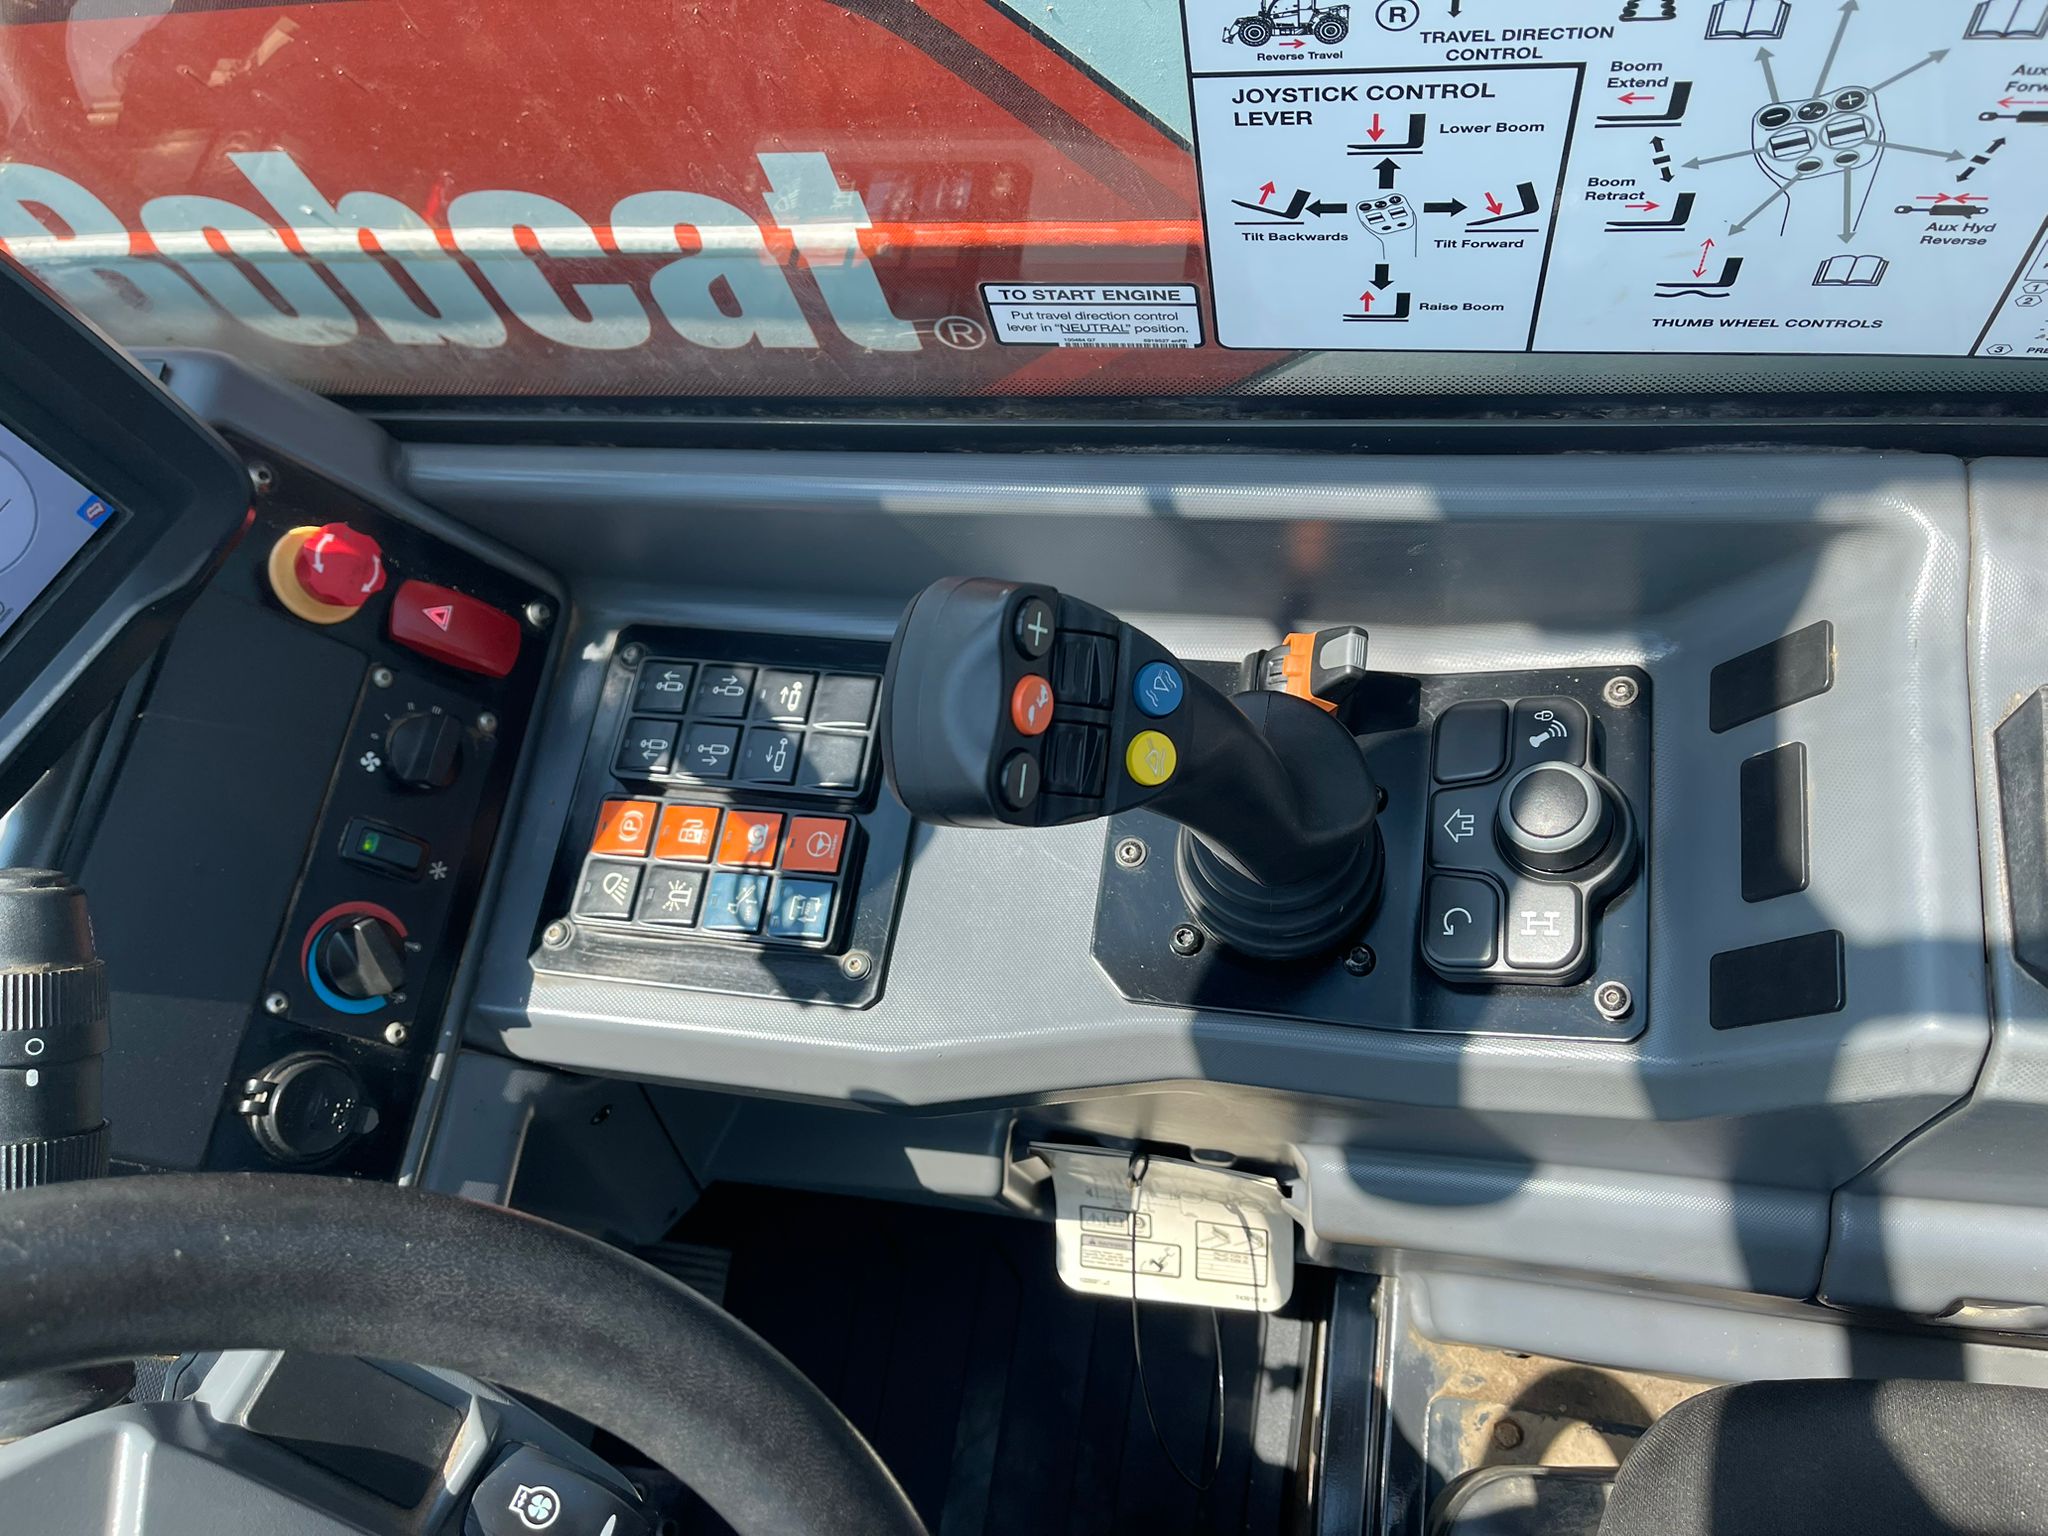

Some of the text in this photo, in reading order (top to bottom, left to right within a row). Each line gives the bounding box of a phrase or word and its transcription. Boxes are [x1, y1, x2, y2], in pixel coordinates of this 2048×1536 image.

[1420, 26, 1614, 44] TRAVEL DIRECTION
[1257, 51, 1343, 61] Reverse Travel
[1446, 47, 1543, 61] CONTROL
[1610, 61, 1663, 72] Boom
[1607, 77, 1669, 88] Extend
[1232, 83, 1495, 104] JOYSTICK CONTROL
[1234, 111, 1312, 126] LEVER
[1440, 122, 1545, 134] Lower Boom
[1588, 177, 1636, 187] Boom
[1585, 191, 1645, 201] Retract
[1925, 222, 1997, 234] Aux Hyd
[1242, 232, 1349, 242] Tilt Backwards
[1919, 236, 1987, 246] Reverse
[1434, 239, 1524, 248] Tilt Forward
[998, 289, 1181, 301] TO START ENGINE
[1419, 302, 1504, 311] Raise Boom
[2022, 297, 2033, 305] 2
[1011, 310, 1178, 321] Put travel direction control
[1007, 323, 1037, 332] lever
[1041, 323, 1052, 332] in
[1134, 324, 1189, 335] position.
[1652, 318, 1883, 329] THUMB WHEEL CONTROLS
